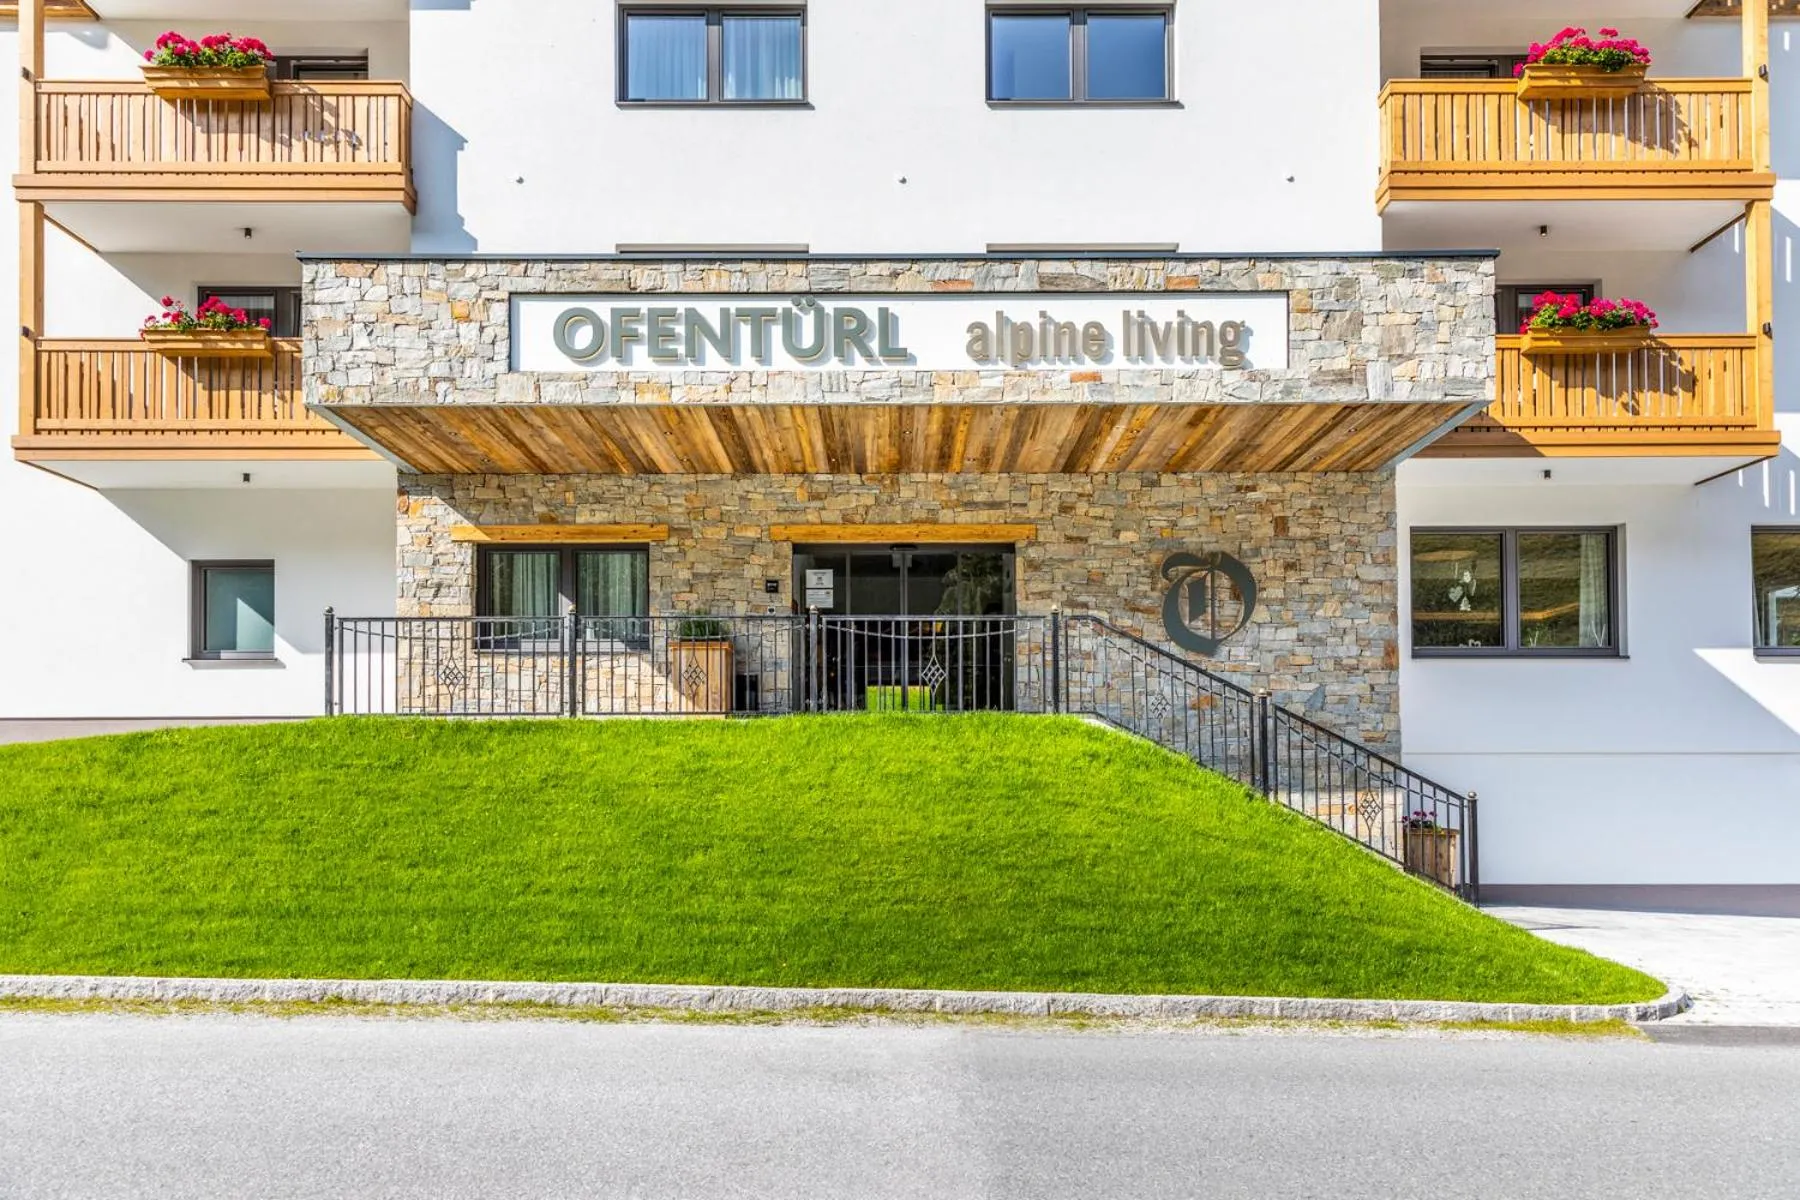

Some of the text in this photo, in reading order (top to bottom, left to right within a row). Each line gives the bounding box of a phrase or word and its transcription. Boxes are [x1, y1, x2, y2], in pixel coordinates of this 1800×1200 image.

[553, 296, 1247, 370] OFENTÜRL alpine living
